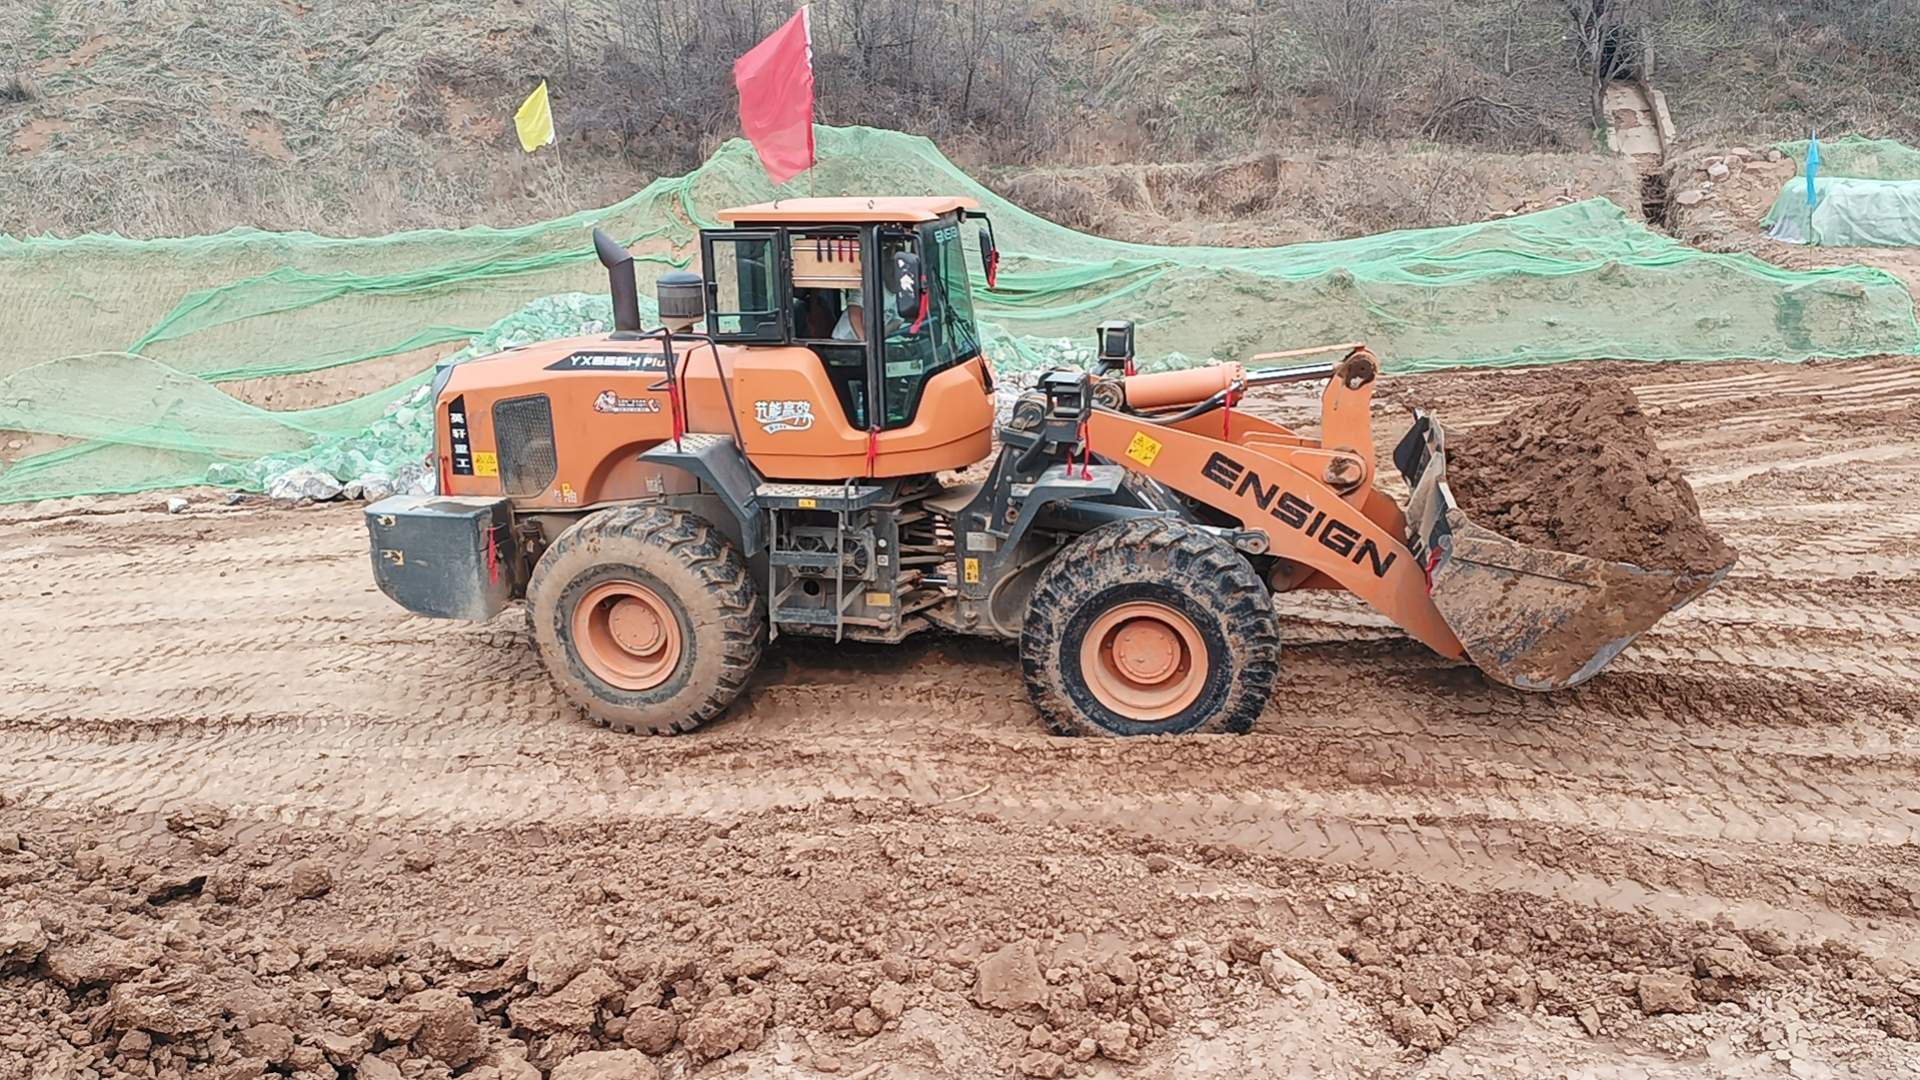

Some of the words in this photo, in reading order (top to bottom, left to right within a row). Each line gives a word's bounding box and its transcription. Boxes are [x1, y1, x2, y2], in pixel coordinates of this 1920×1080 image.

[642, 357, 667, 368] Plu
[754, 400, 815, 425] 节能高效
[449, 412, 471, 468] 英轩重工
[1201, 451, 1397, 578] ENSIGN
